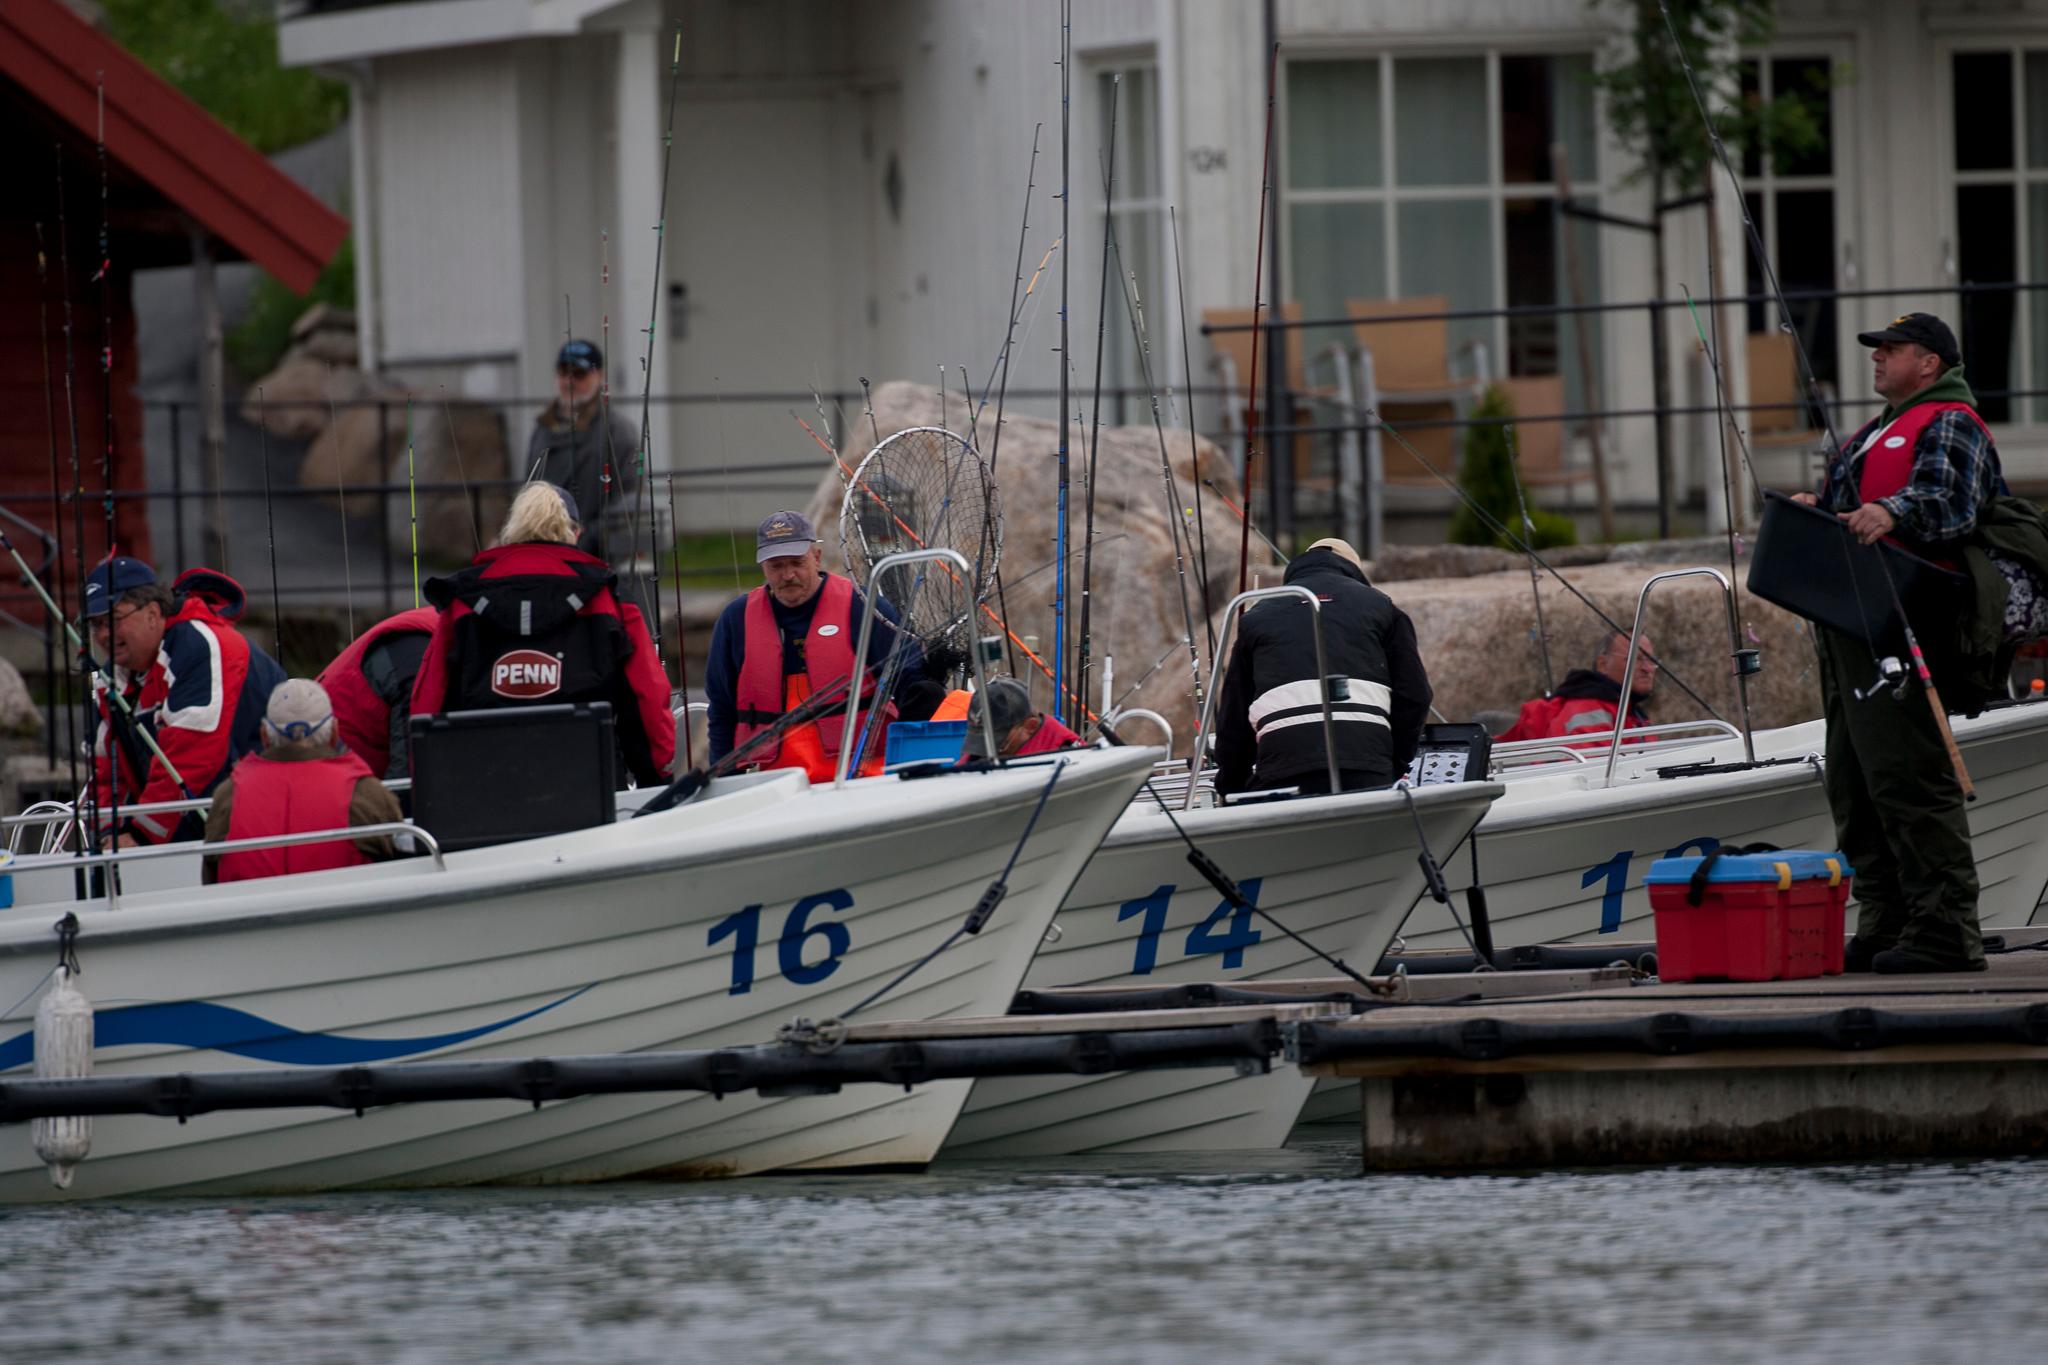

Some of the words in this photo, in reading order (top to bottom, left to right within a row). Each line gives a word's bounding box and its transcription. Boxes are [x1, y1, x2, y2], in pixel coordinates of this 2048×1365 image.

[496, 663, 557, 686] PENN
[1117, 877, 1264, 976] 14
[1581, 837, 1720, 934] 1
[707, 888, 855, 996] 16
